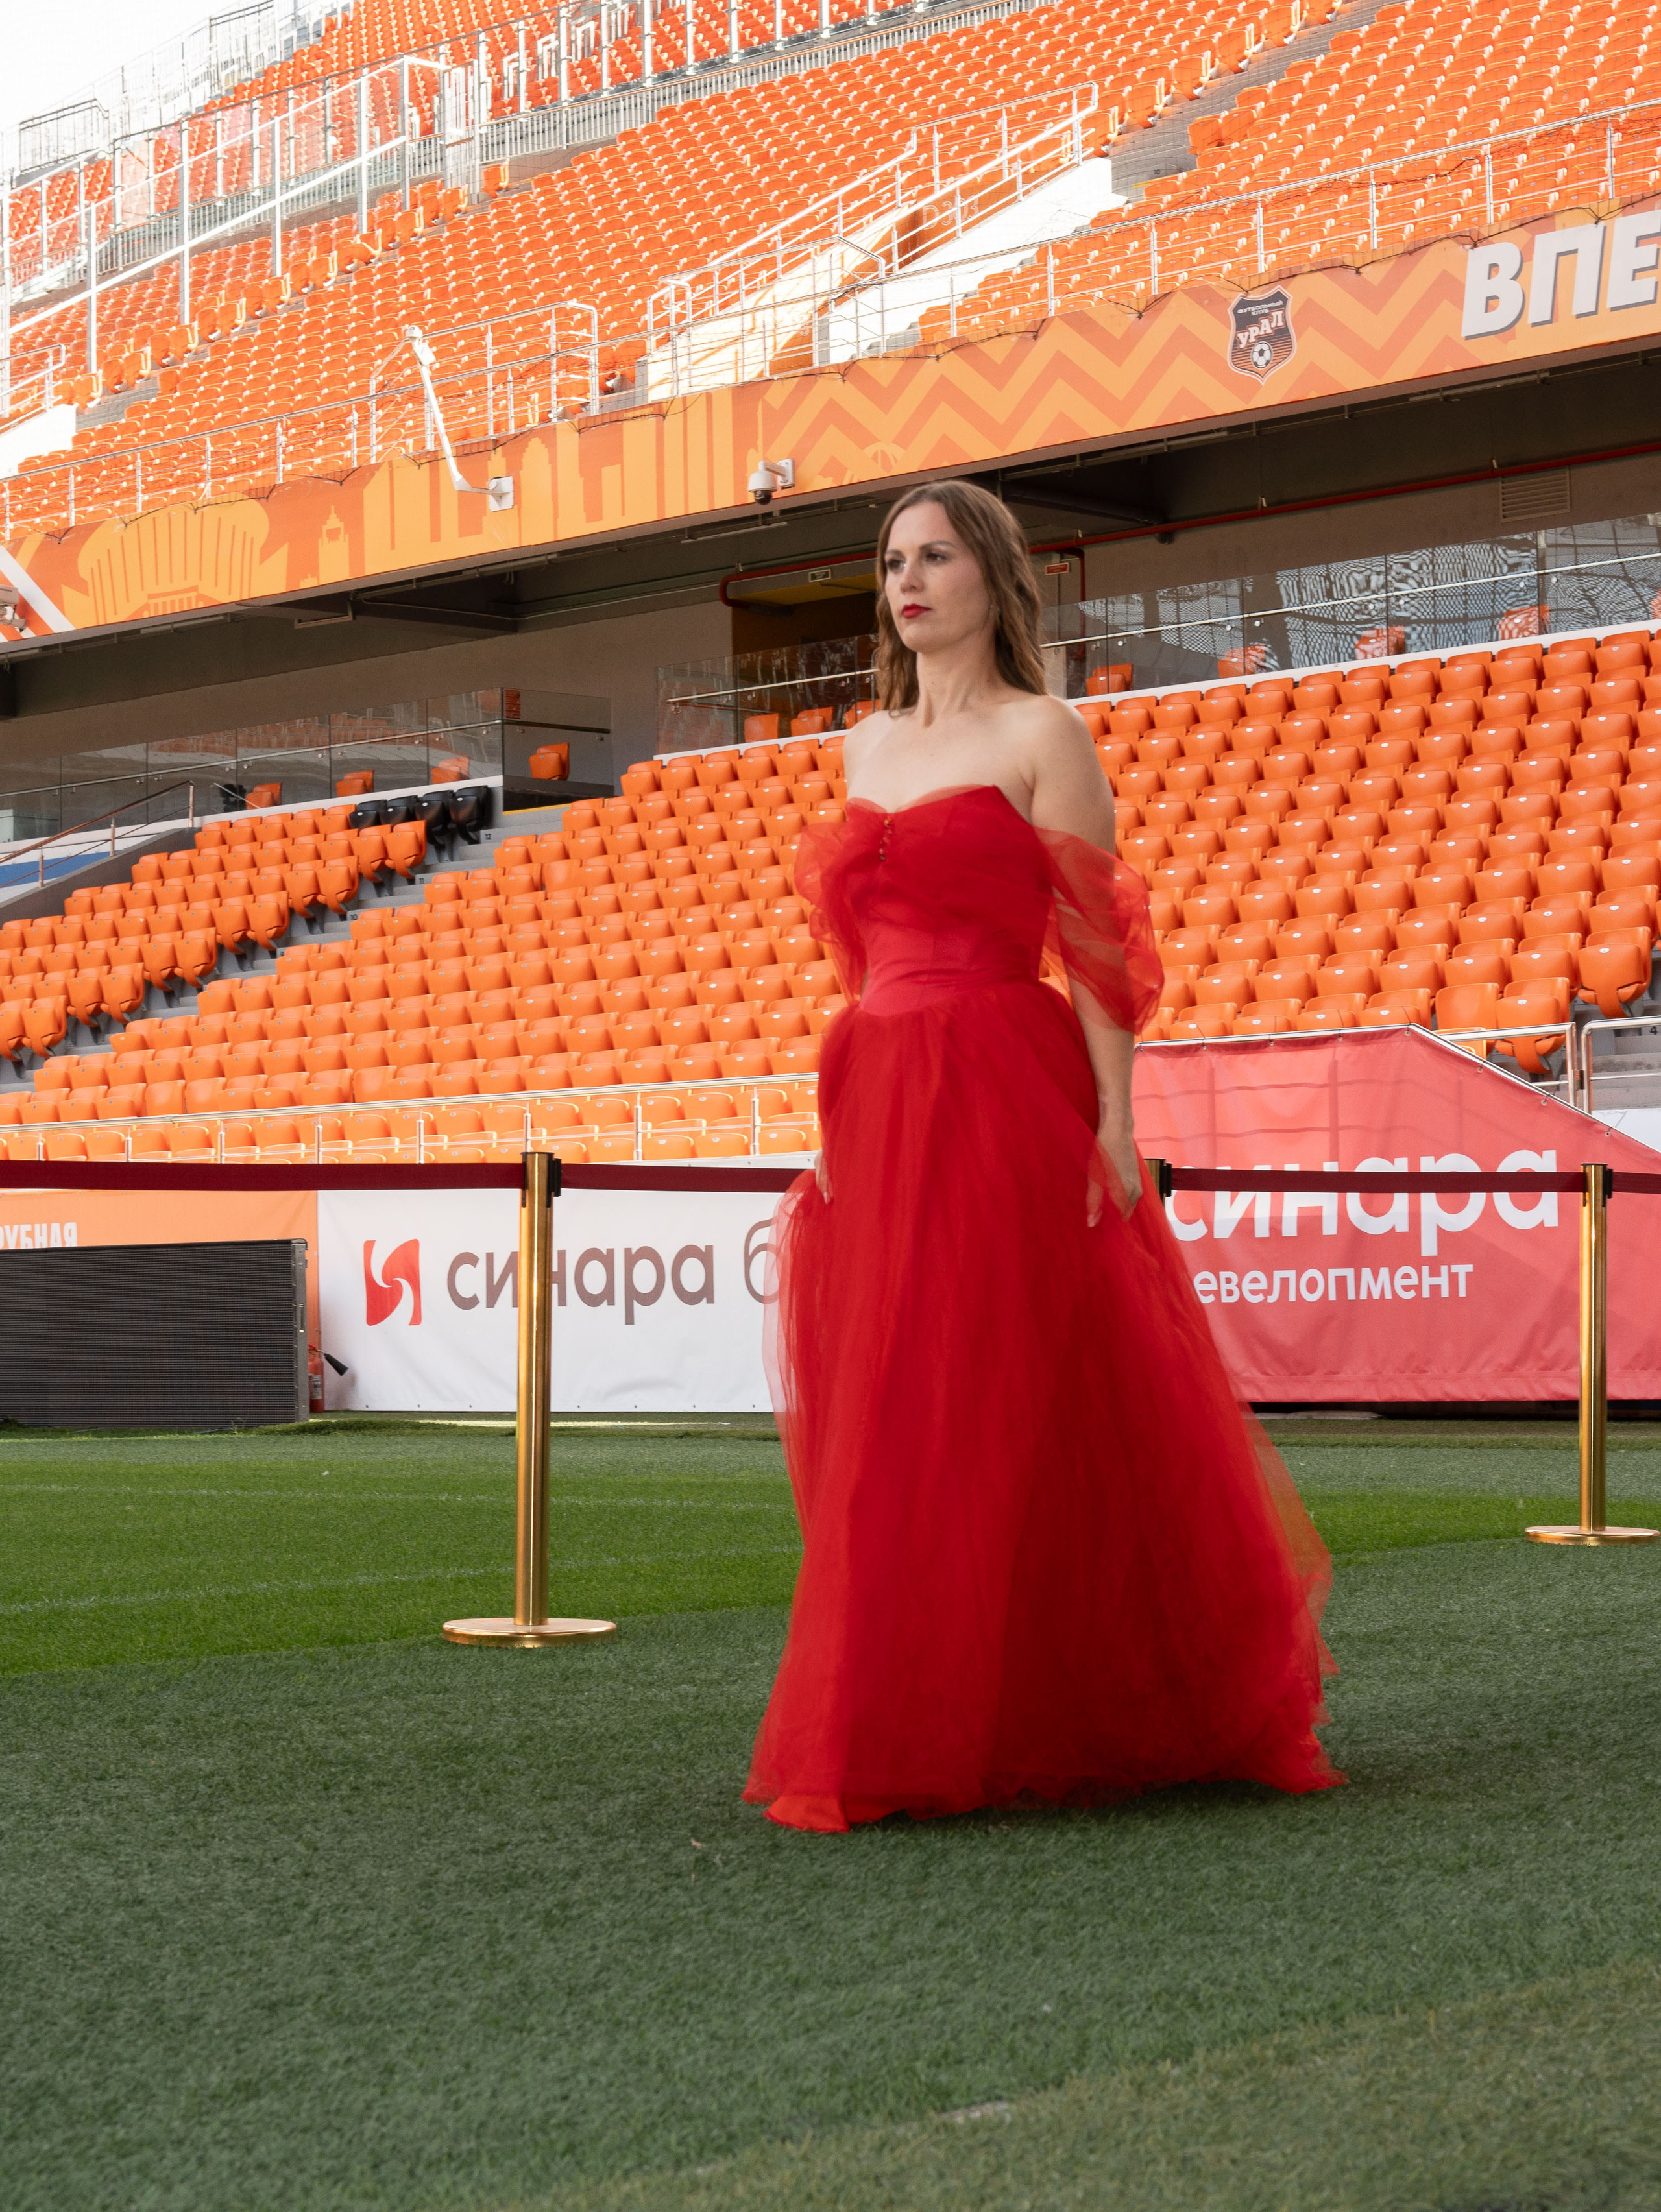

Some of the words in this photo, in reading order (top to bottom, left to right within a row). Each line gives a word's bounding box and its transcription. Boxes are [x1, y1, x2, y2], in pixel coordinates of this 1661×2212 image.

[1461, 209, 1661, 340] ВПЕ
[1237, 300, 1283, 313] ФУТБОЛЬНЫЙ
[1237, 309, 1285, 349] УРАЛ
[1650, 1026, 1658, 1035] 4
[1165, 1149, 1558, 1256] синара
[0, 1222, 77, 1249] УБНАЯ
